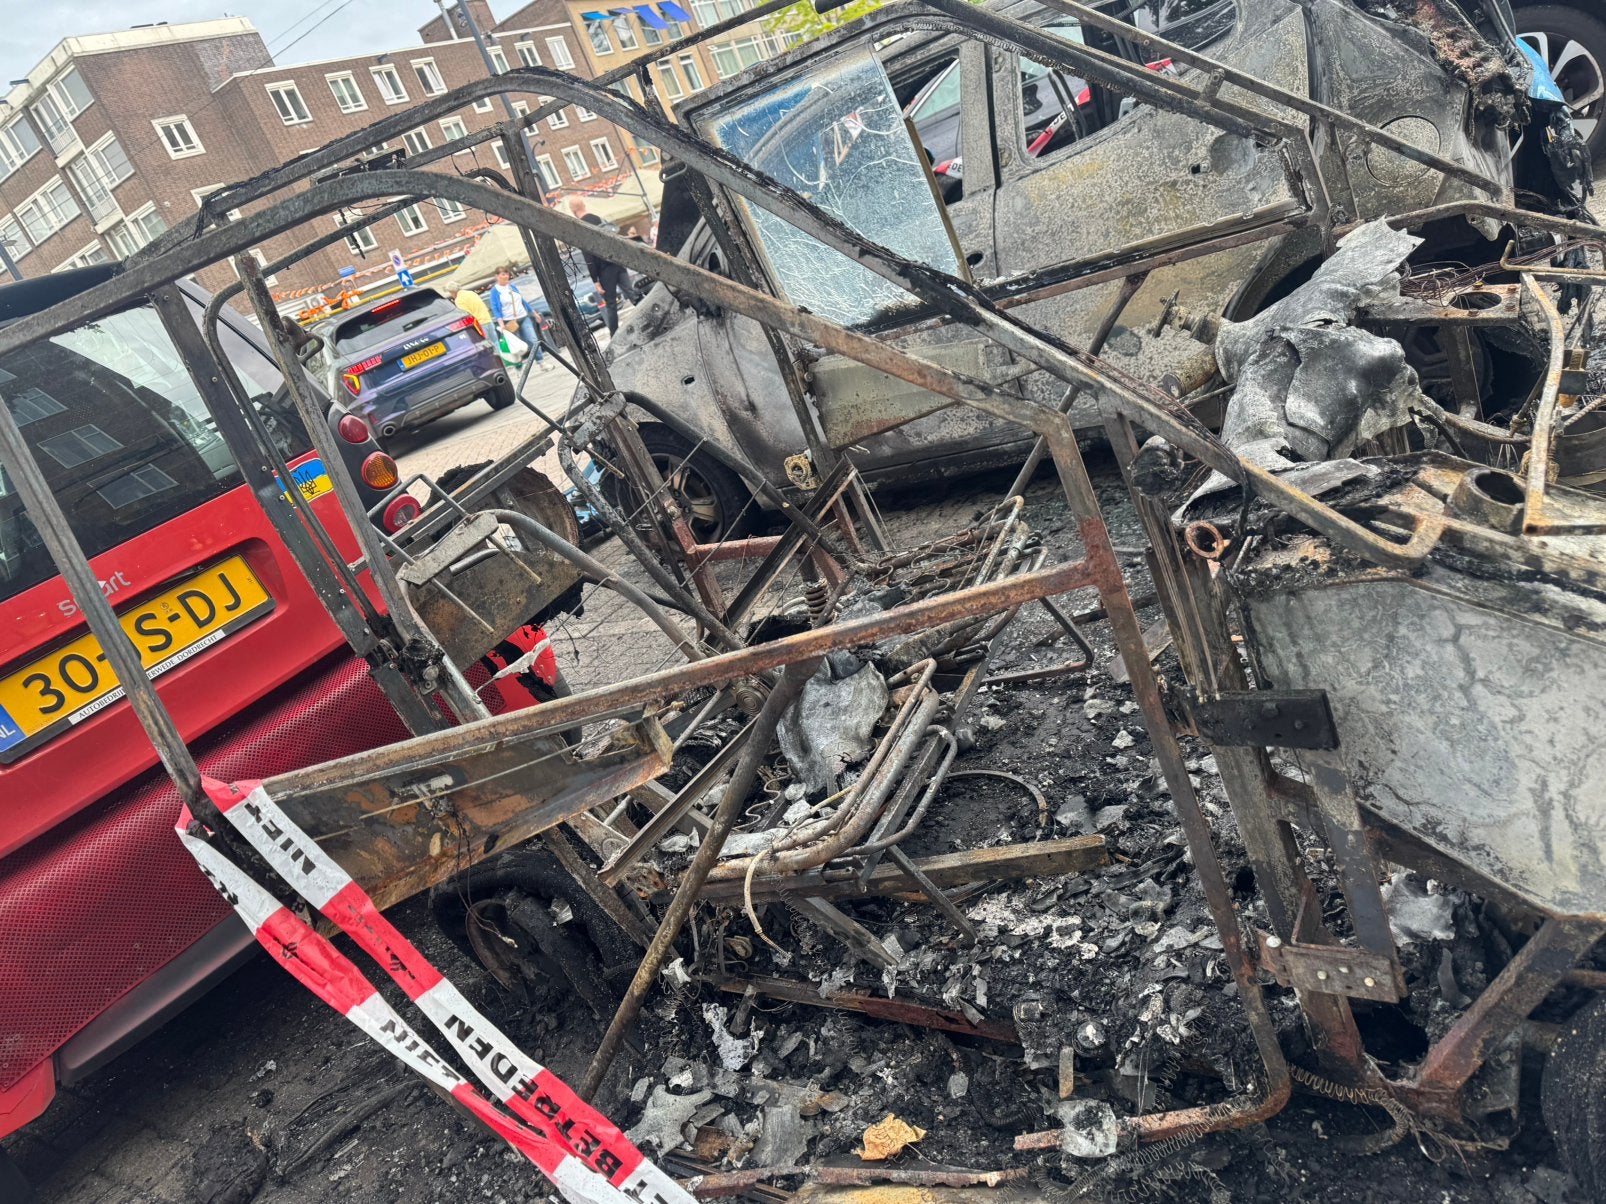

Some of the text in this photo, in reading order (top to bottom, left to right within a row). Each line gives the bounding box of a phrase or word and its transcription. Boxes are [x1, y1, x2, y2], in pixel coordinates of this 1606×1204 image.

[22, 573, 241, 715] 30-S-DJ
[57, 571, 131, 616] sart
[78, 634, 218, 719] AUTOBEDRIJ ERWEDE DORDRECHT
[444, 1014, 624, 1181] BETREDEN
